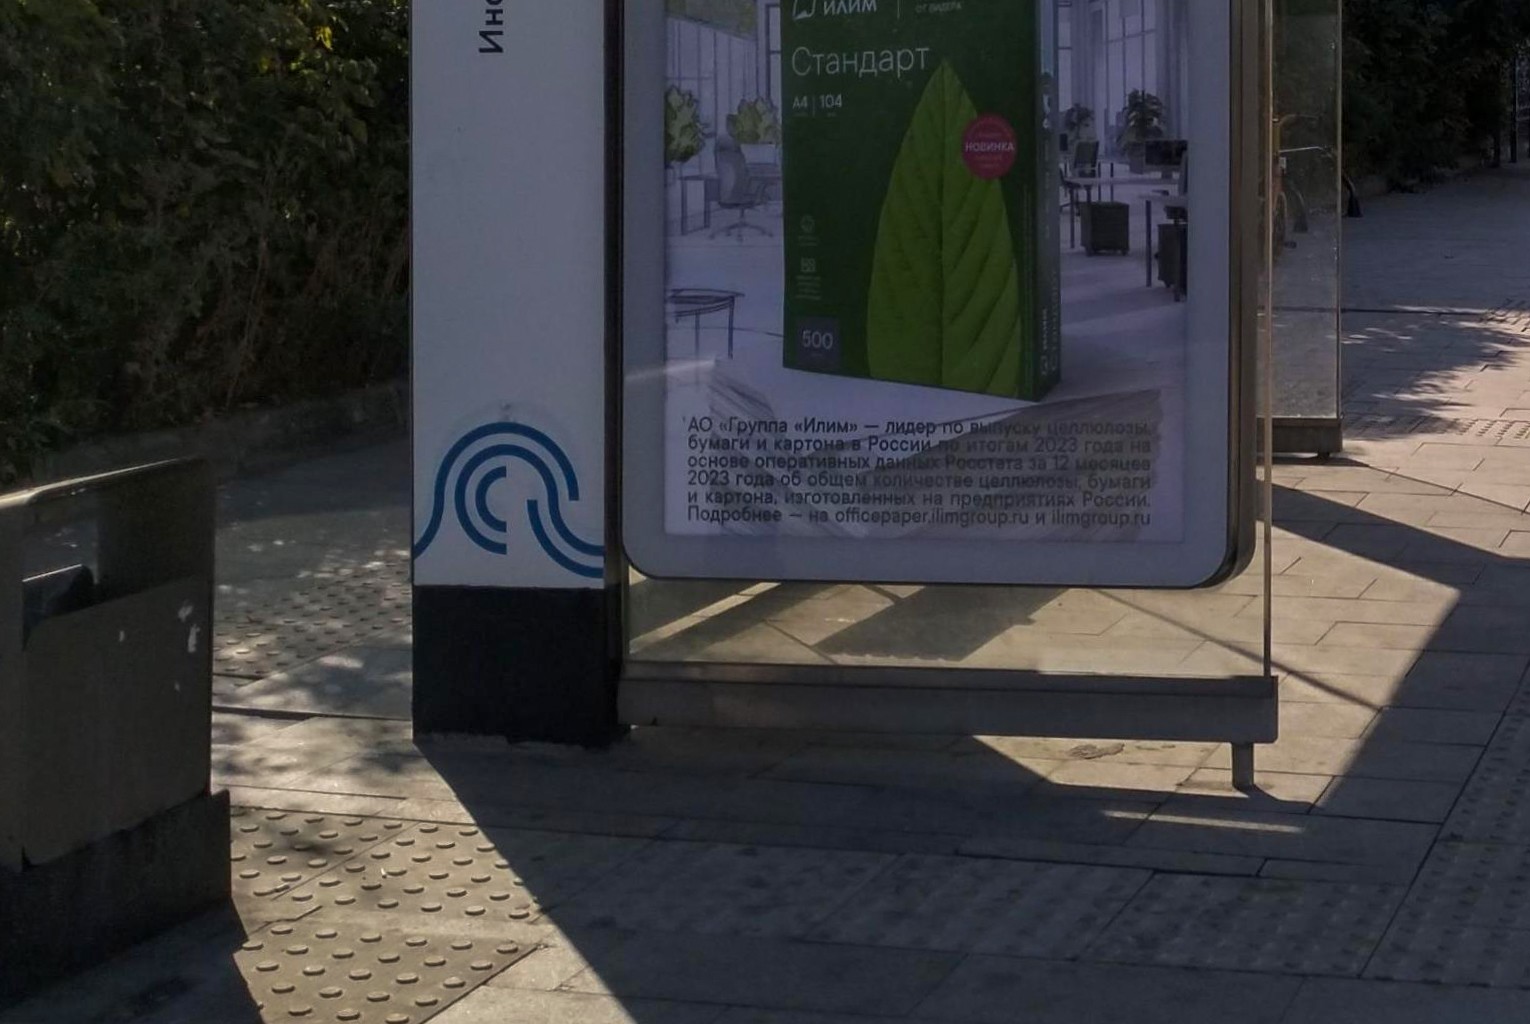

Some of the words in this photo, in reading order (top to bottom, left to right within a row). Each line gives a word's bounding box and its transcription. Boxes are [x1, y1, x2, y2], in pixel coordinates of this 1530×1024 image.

[792, 46, 930, 79] Стандарт
[965, 142, 1015, 152] НОВИНКА
[802, 330, 833, 349] 500
[719, 416, 787, 436] «Группа
[795, 417, 858, 434] «Илим»
[885, 420, 936, 436] лидер
[943, 422, 963, 434] по
[970, 422, 1041, 437] выпуску
[688, 434, 750, 451] бумаги
[757, 439, 767, 450] и
[774, 438, 850, 453] картона
[852, 439, 861, 450] в
[869, 436, 931, 451] России
[938, 440, 960, 453] по
[967, 440, 1028, 453] итогам
[1035, 436, 1078, 452] 2023
[1085, 440, 1125, 454] года
[1131, 440, 1150, 452] на
[688, 456, 750, 469] основе
[755, 456, 870, 473] оперативных
[876, 456, 940, 471] данных
[945, 455, 1022, 471] Росстата
[1029, 457, 1046, 470] за
[1053, 455, 1069, 470] 12
[1076, 457, 1150, 473] месяцев
[688, 470, 730, 486] 2023
[735, 474, 774, 487] года
[781, 471, 801, 486] об
[807, 471, 867, 487] общем
[873, 475, 973, 488] количестве
[1087, 474, 1150, 492] бумаги
[688, 492, 697, 503] и
[705, 492, 778, 507] картона,
[784, 492, 914, 505] изготовленных
[923, 492, 943, 504] на
[951, 492, 1074, 509] предприятиях
[688, 506, 782, 524] Подробнее
[809, 511, 828, 522] на
[835, 507, 1029, 526] officepaper.ilimgroup.ru
[1035, 511, 1046, 524] и
[1052, 508, 1150, 527] ilimgroup.ru
